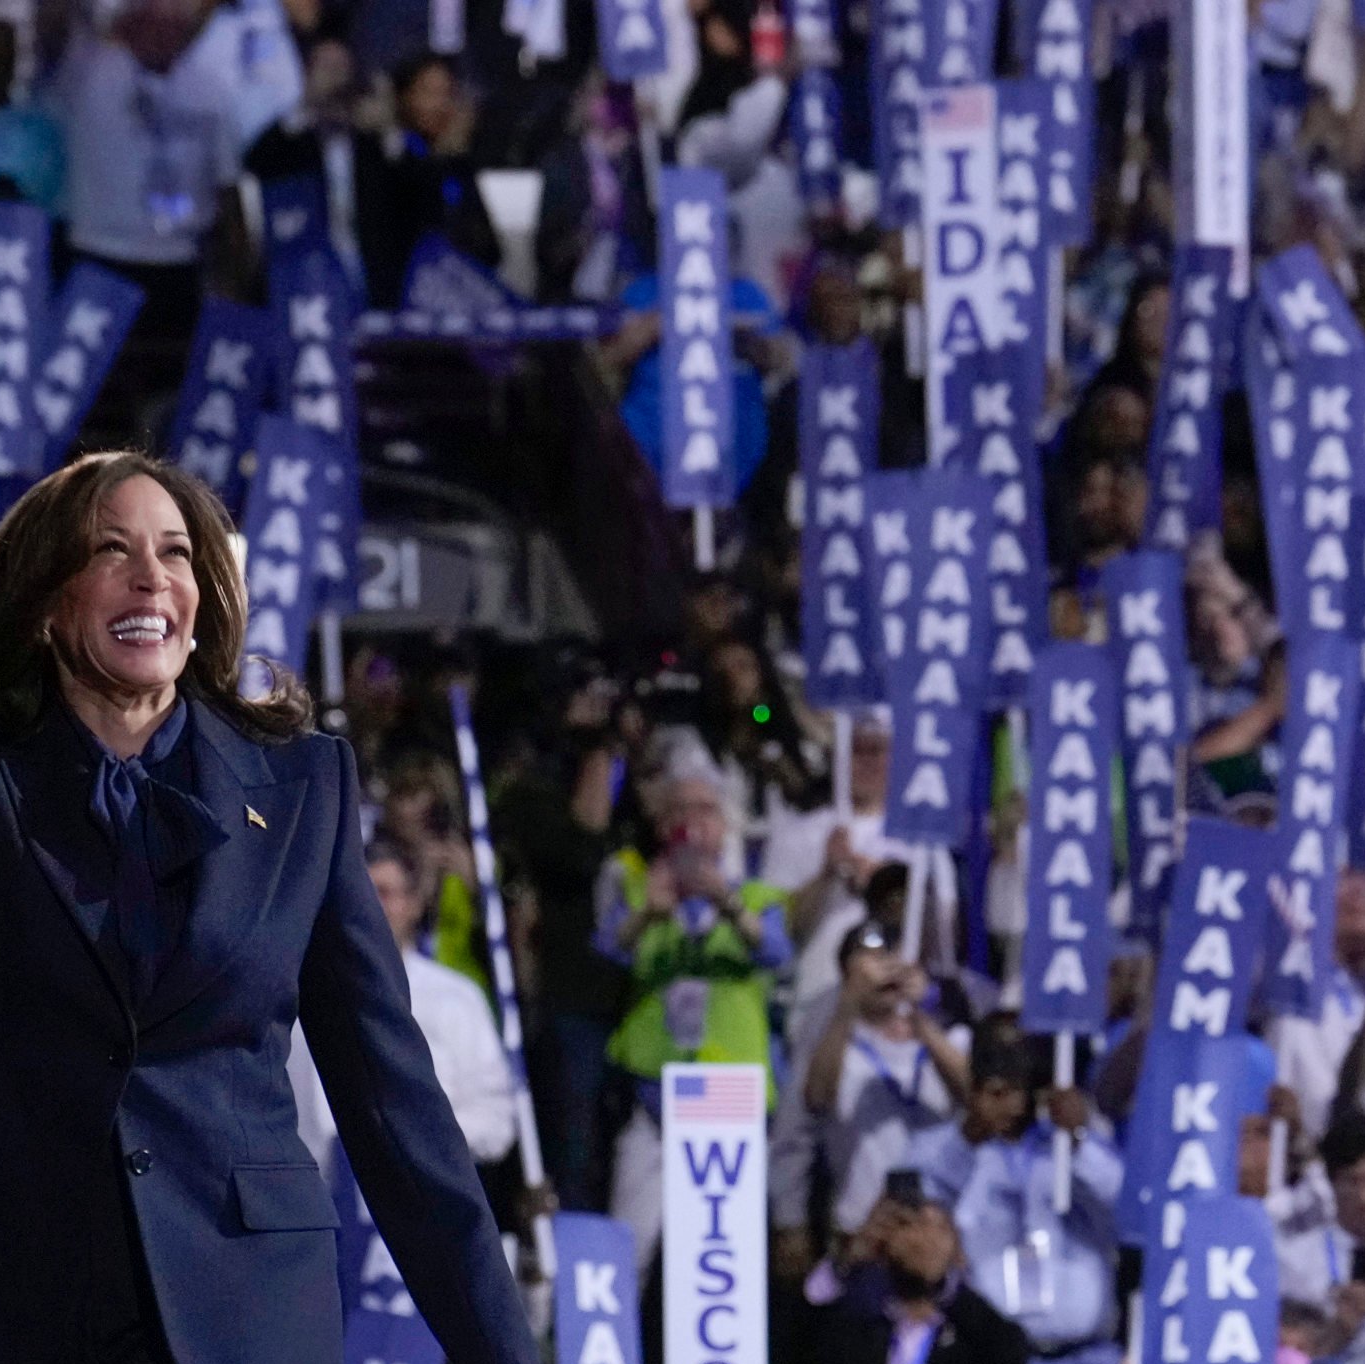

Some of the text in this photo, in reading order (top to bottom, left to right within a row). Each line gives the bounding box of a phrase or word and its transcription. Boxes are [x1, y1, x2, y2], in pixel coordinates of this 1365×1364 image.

[673, 198, 721, 474] KAMALA
[938, 150, 984, 350] IDA
[997, 112, 1038, 346] KAMAL
[33, 303, 110, 433] KAM
[180, 335, 250, 486] KAM
[1157, 273, 1217, 547] KAMALA
[247, 457, 311, 655] KAMA
[815, 384, 863, 676] KAMALA
[1303, 385, 1351, 628] KAMAL
[908, 505, 978, 810] KAMALA
[1040, 678, 1099, 995] KAMALA
[1170, 865, 1247, 1036] KAM
